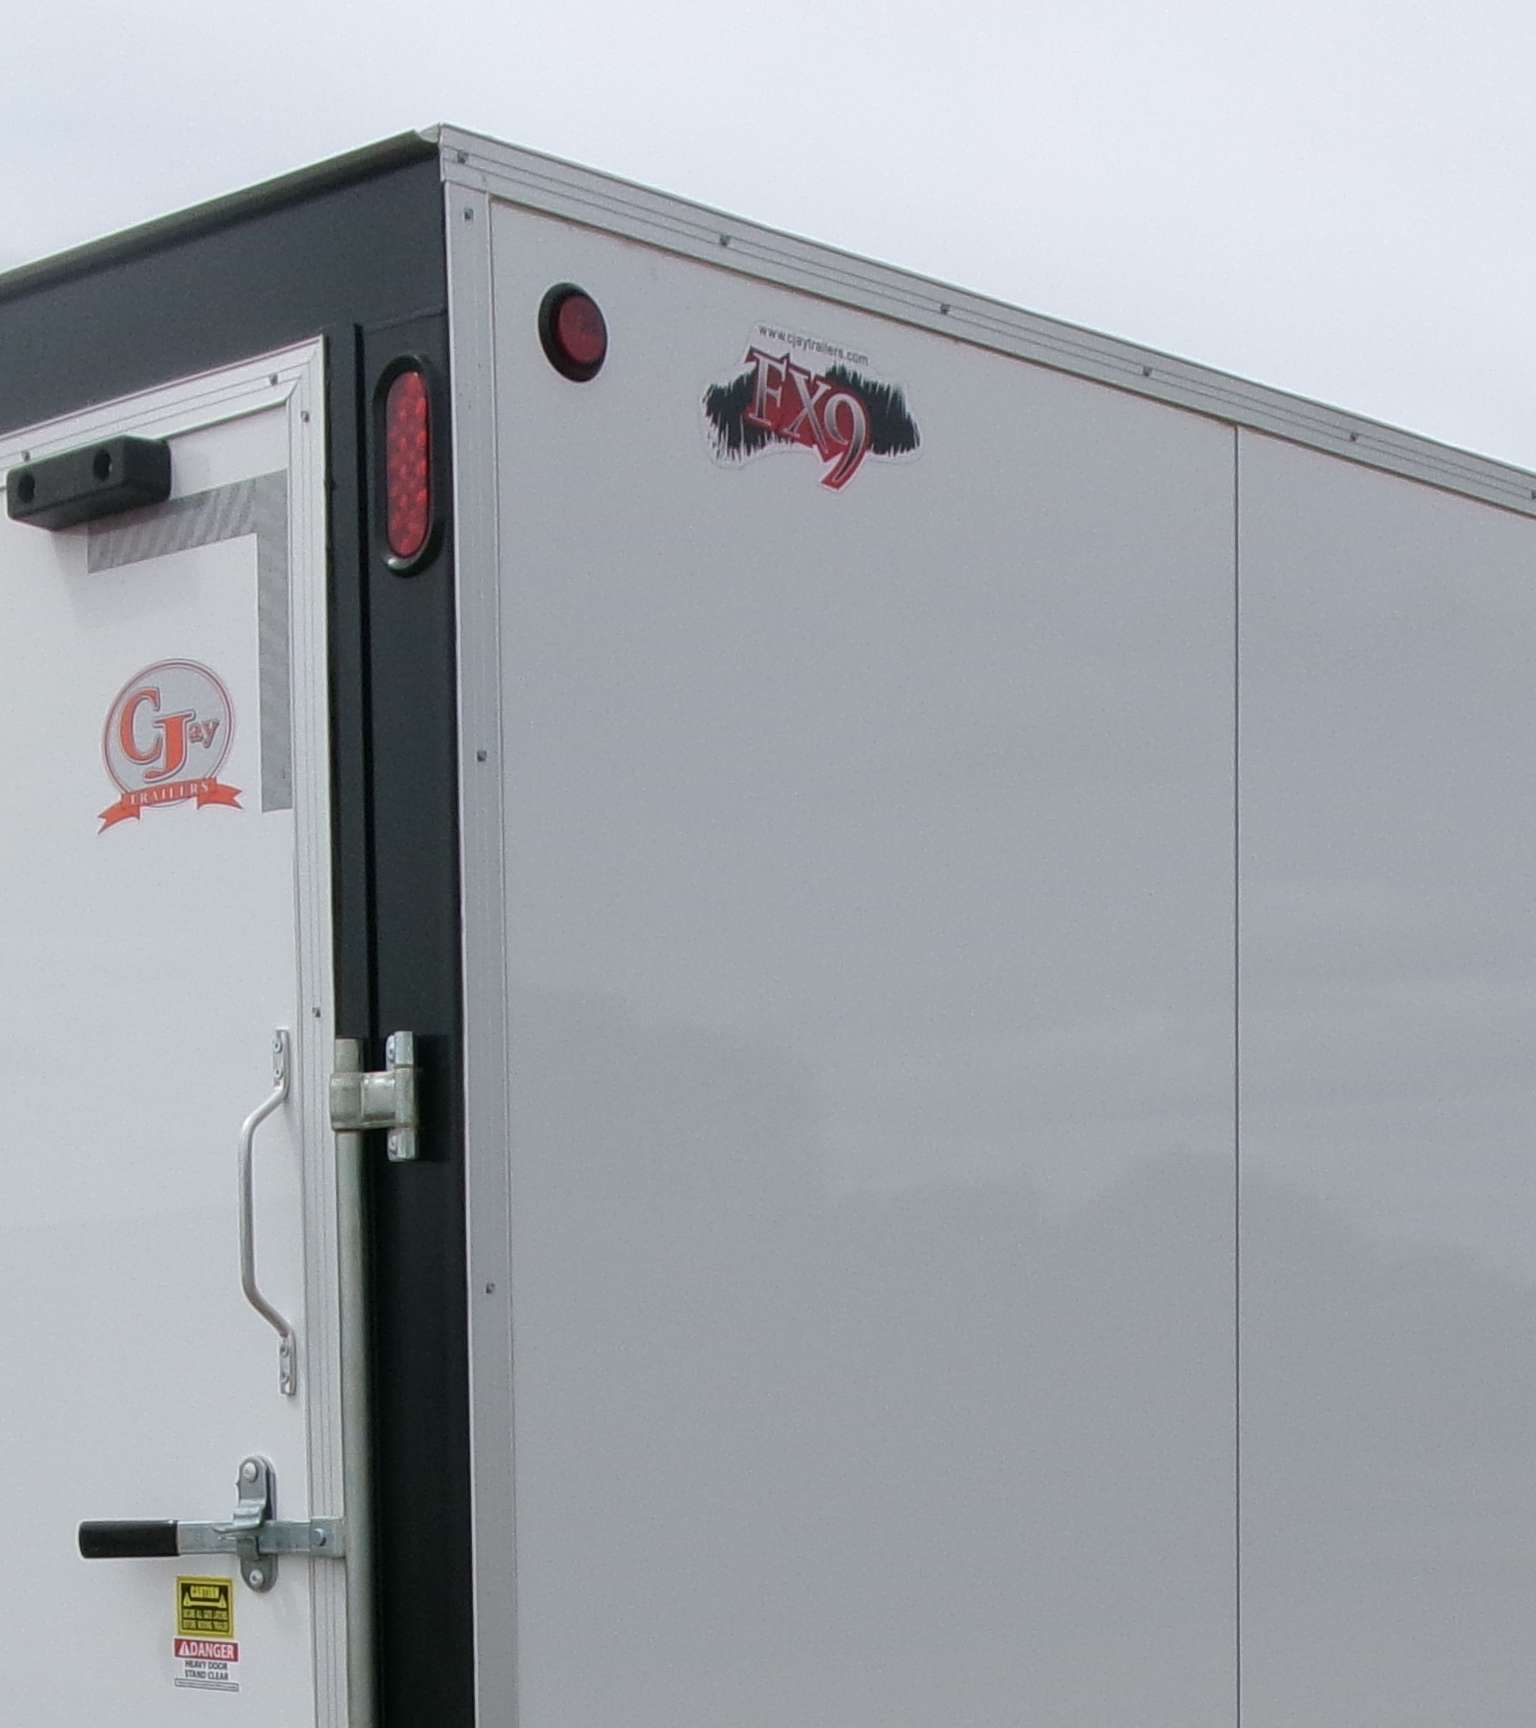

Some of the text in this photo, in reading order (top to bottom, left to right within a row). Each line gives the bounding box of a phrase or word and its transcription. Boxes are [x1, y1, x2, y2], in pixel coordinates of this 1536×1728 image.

[758, 325, 869, 366] www.cjaytrailers.com
[745, 346, 868, 490] FX9
[190, 1643, 235, 1660] DANGER
[185, 1660, 228, 1671] HEAVY DOOR
[185, 1669, 229, 1681] STAND CLEAR
